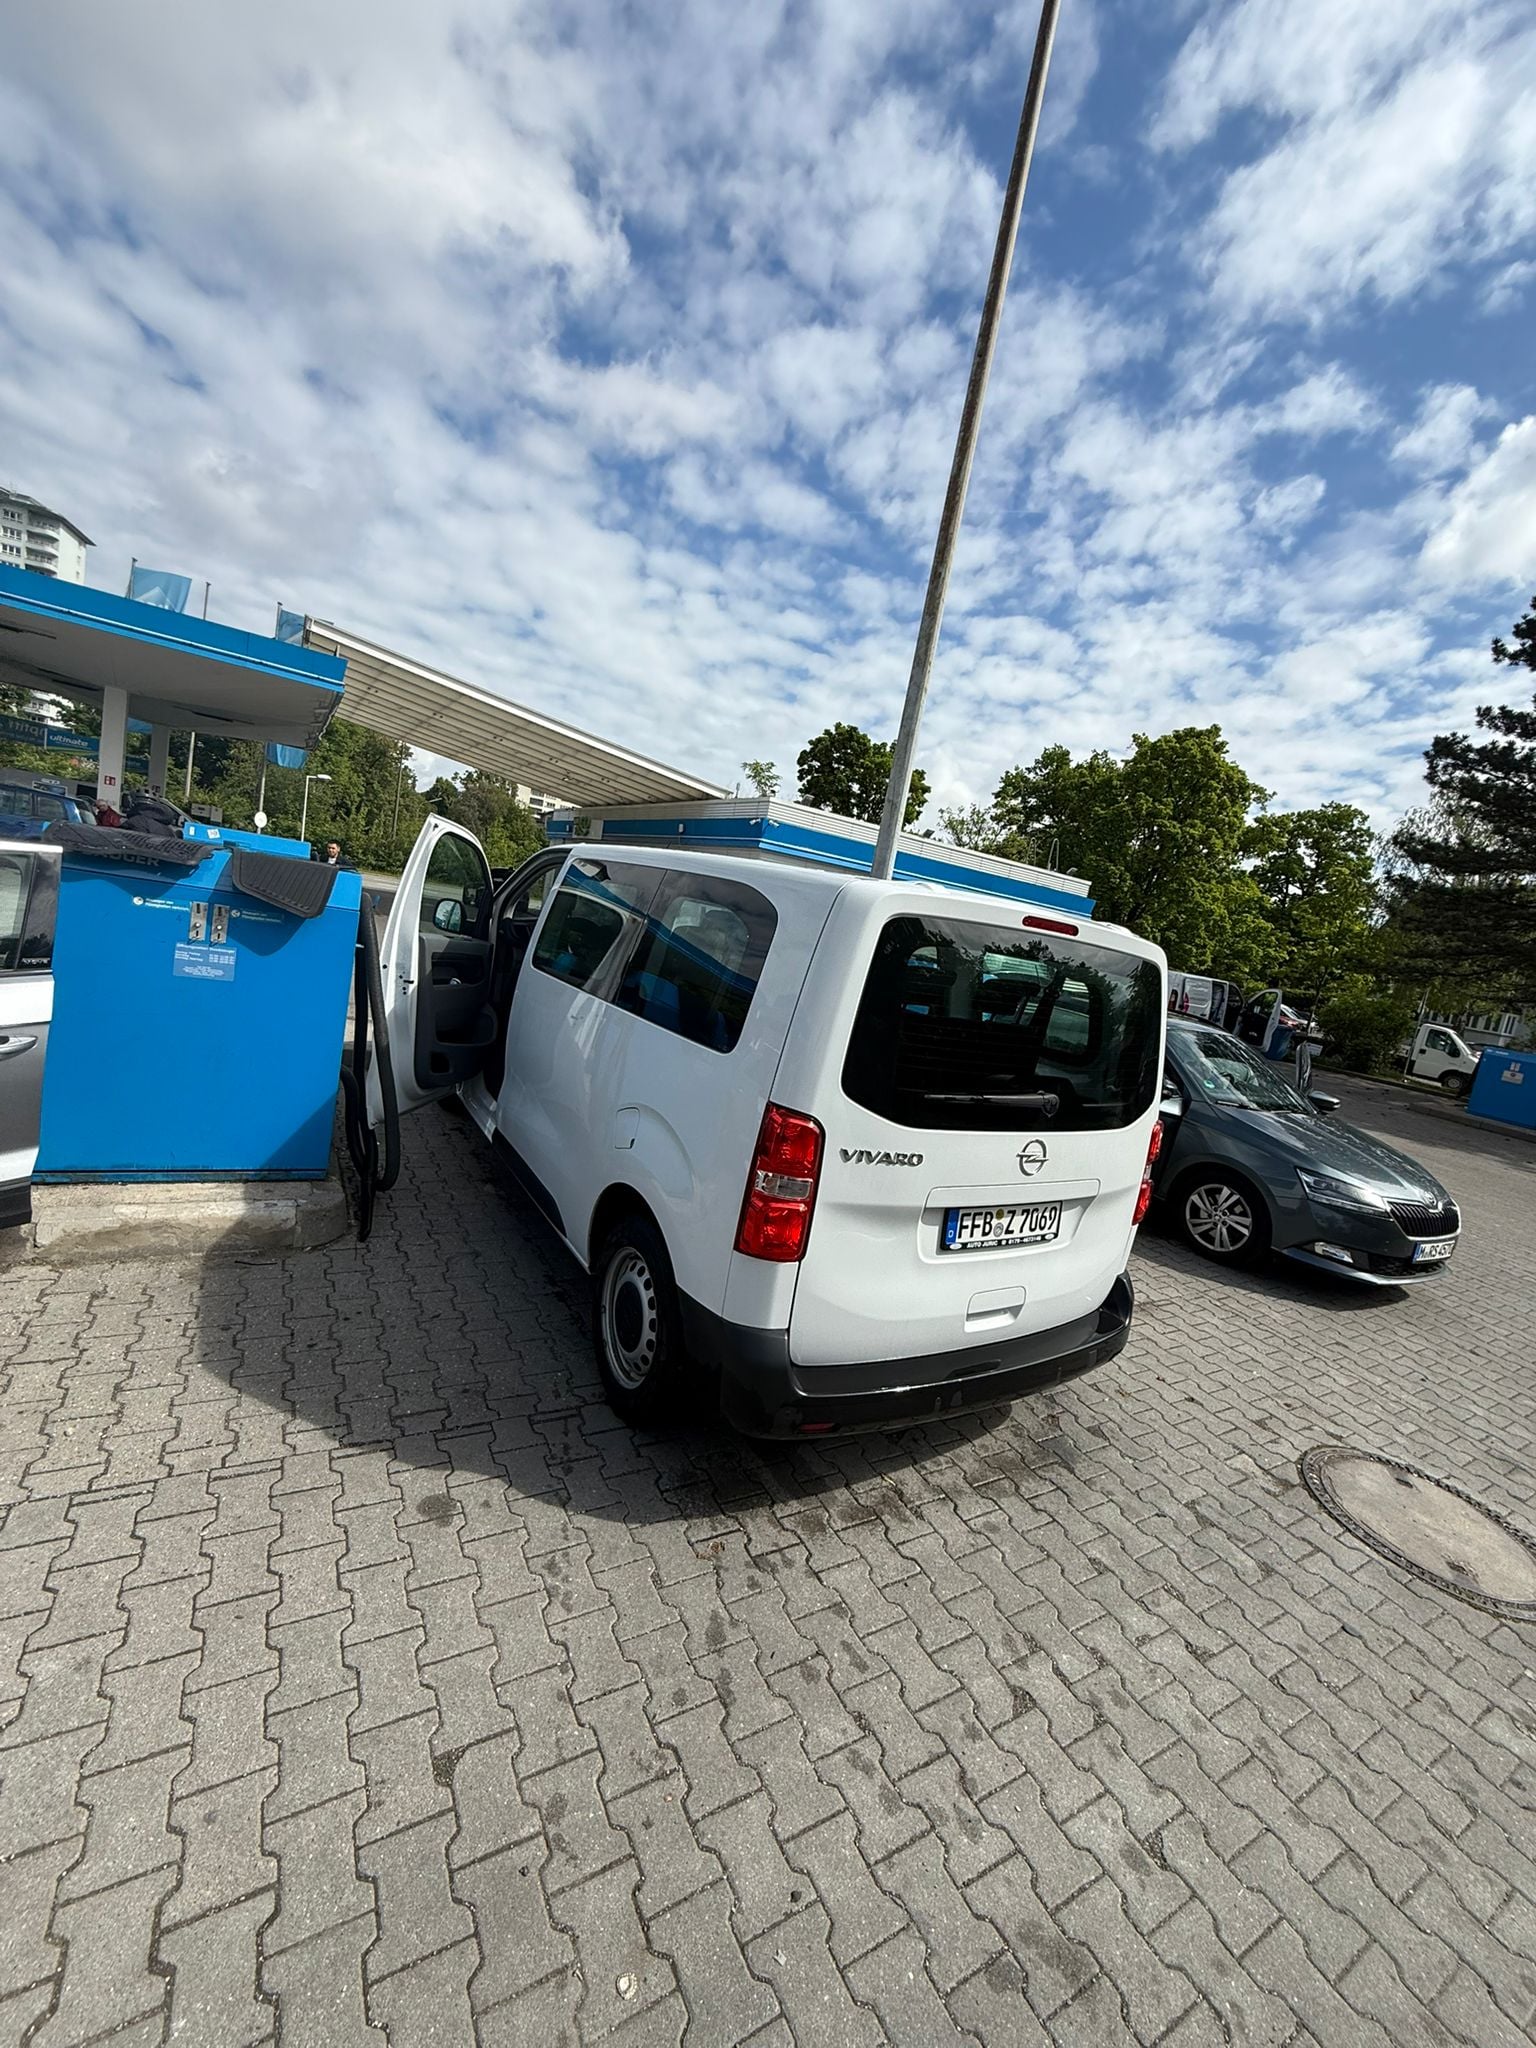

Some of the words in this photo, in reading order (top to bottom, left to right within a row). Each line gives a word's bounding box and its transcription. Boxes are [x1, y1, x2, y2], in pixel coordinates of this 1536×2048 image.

[839, 1148, 924, 1167] VIVARO
[958, 1211, 994, 1239] FFB
[1019, 1206, 1058, 1233] 7069
